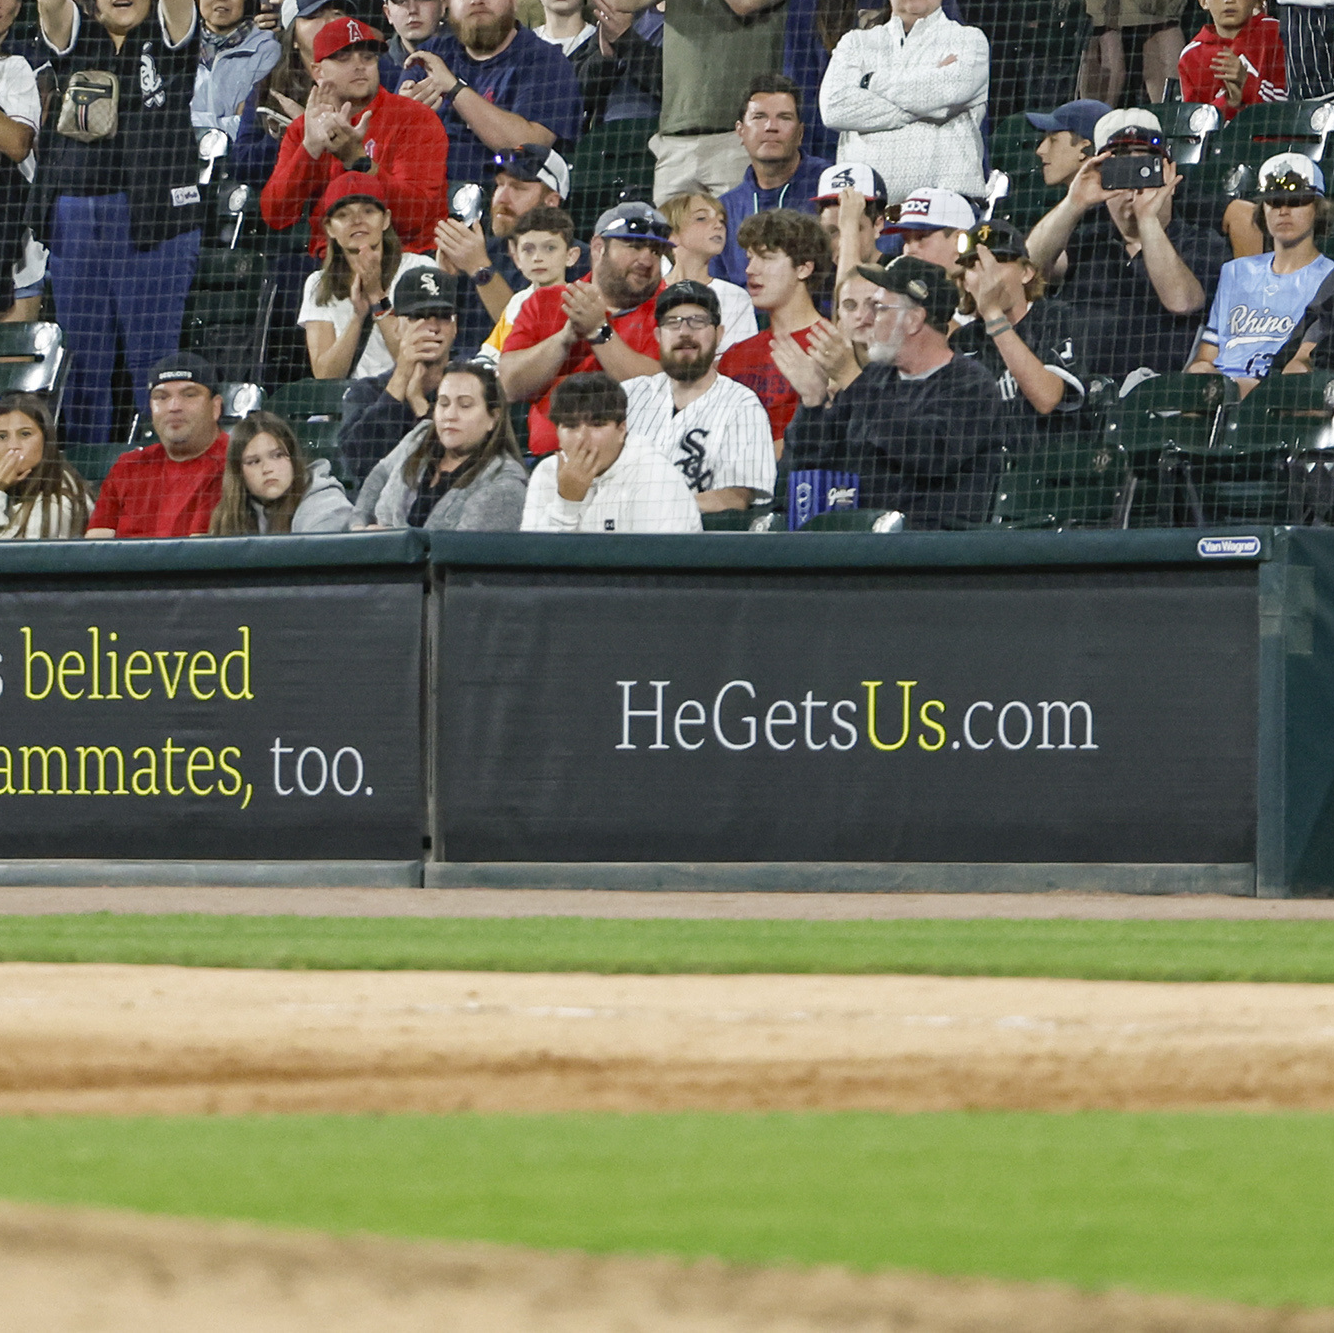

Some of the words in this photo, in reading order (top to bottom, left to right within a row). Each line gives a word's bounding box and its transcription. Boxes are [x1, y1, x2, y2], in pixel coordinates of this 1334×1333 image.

[1203, 540, 1222, 552] Van
[1222, 539, 1257, 554] Wagner
[20, 626, 255, 701] believed
[614, 679, 1100, 751] HeGetsUs.com
[269, 736, 374, 796] too.
